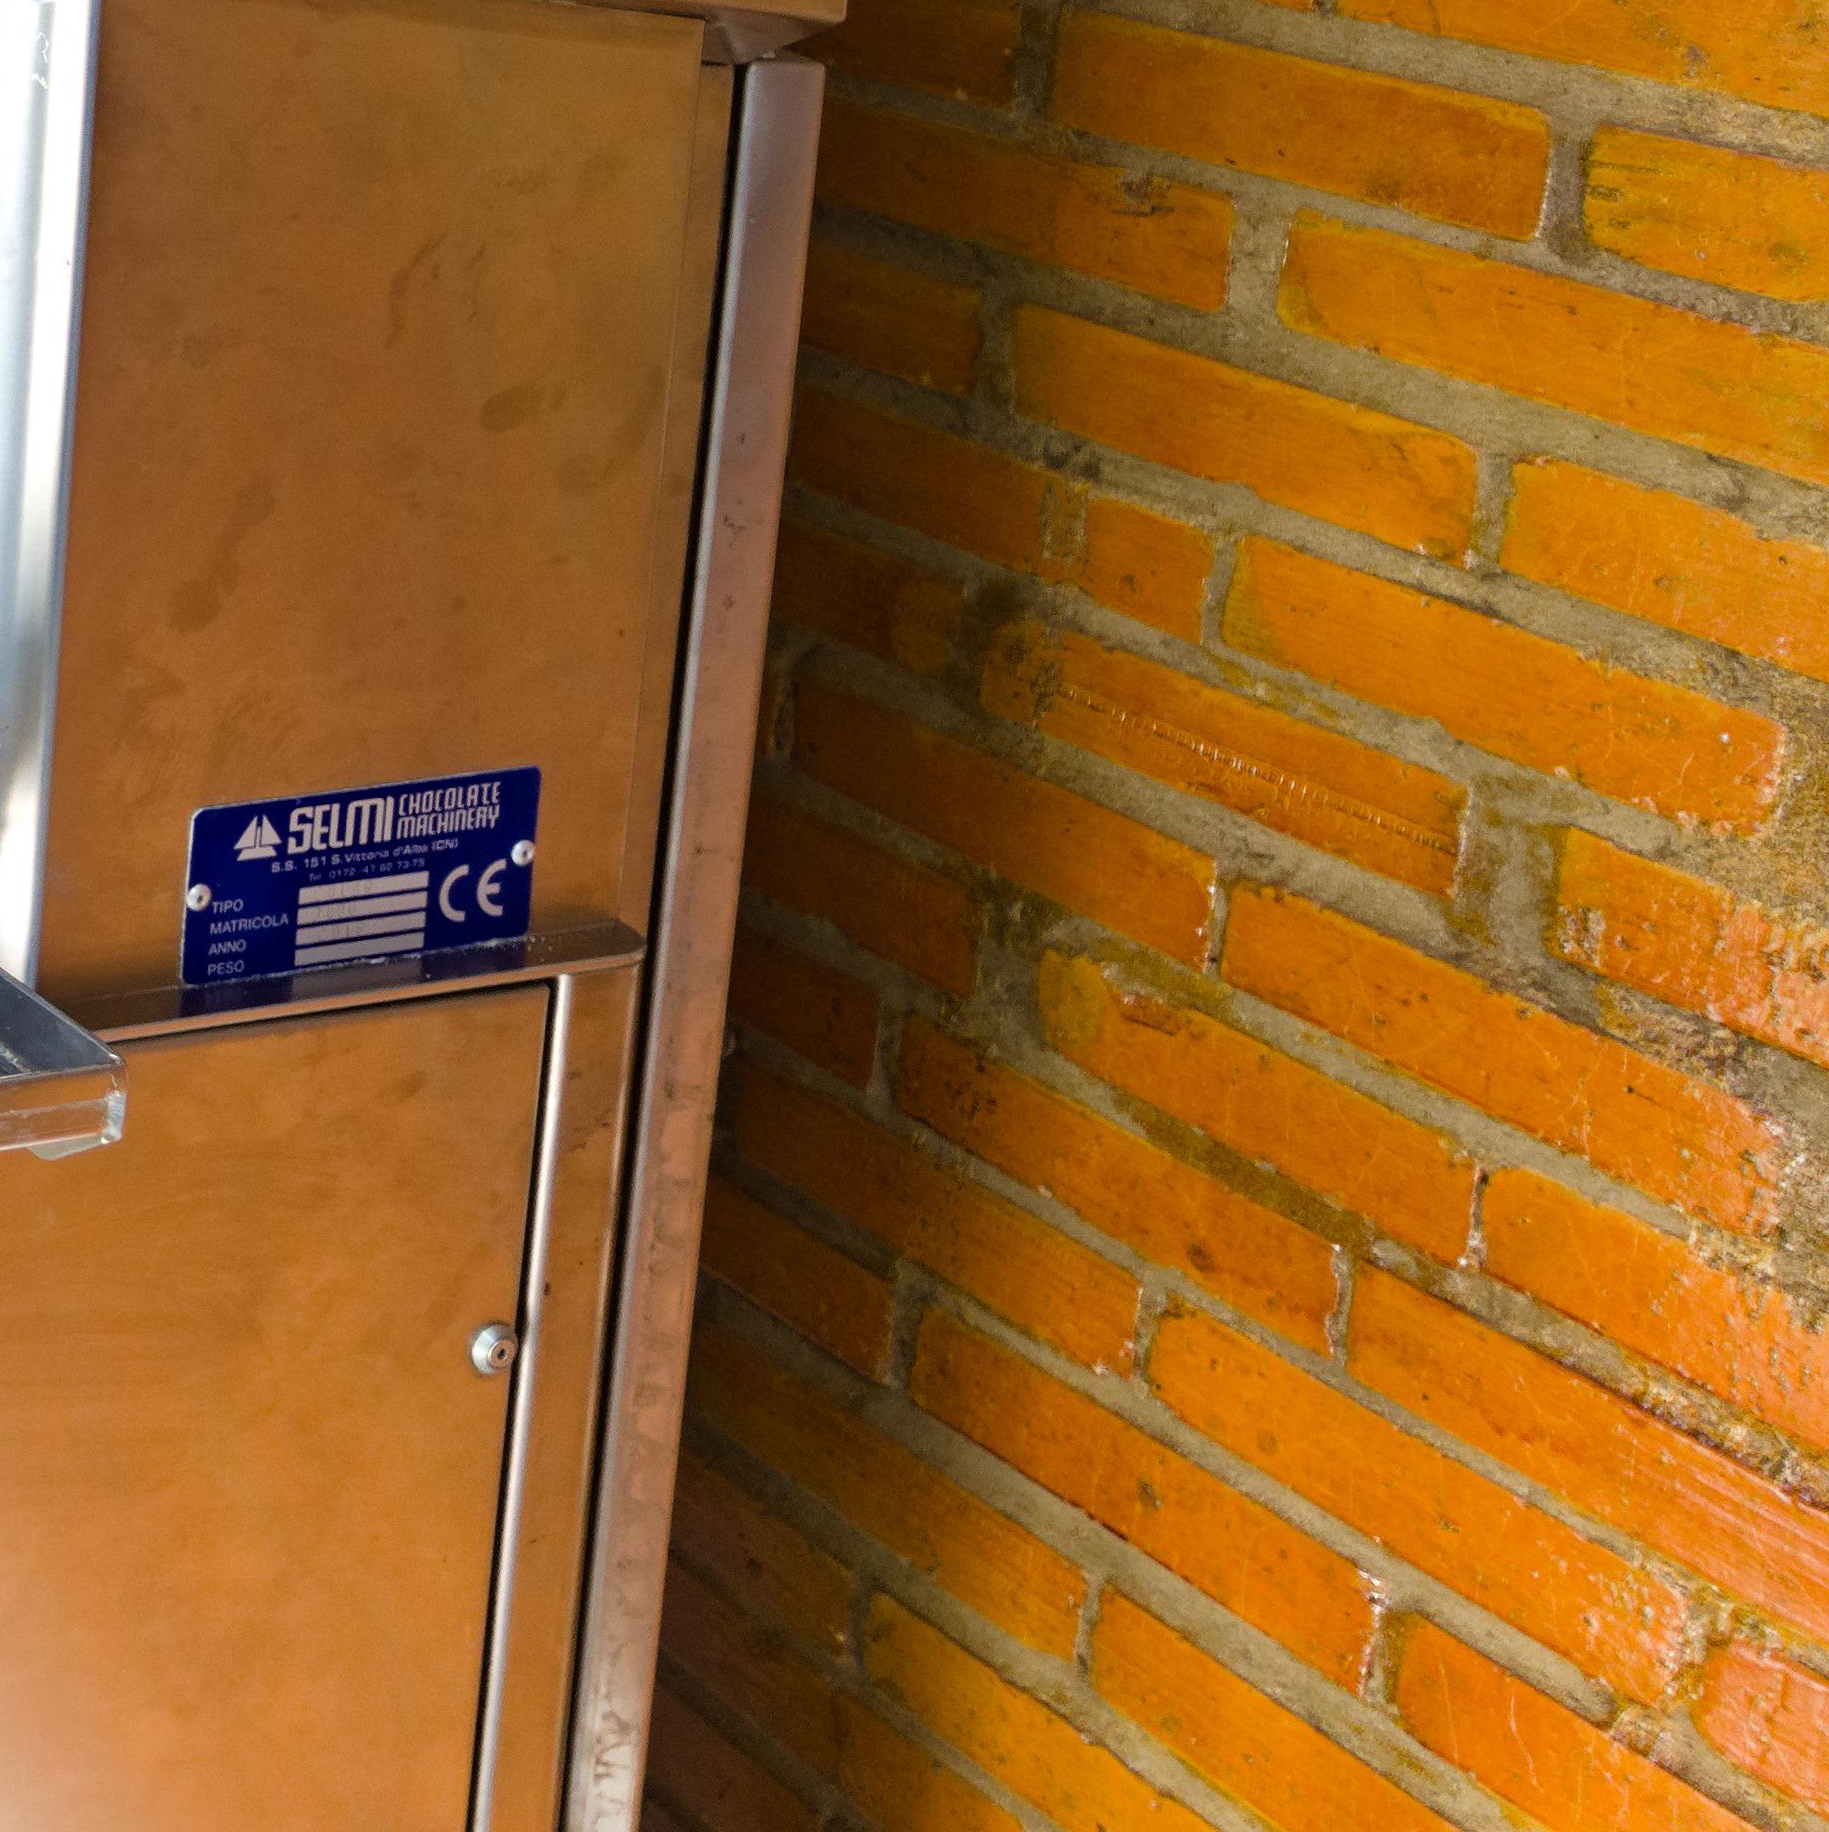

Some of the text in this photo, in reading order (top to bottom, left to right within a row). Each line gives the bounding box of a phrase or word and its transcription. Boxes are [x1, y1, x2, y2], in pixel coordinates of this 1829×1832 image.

[398, 781, 501, 816] CHOCOLATE
[287, 795, 394, 855] SELMI
[396, 804, 500, 840] MACHINERY
[439, 858, 507, 922] CE
[212, 899, 245, 915] TIPO
[210, 913, 290, 936] MATRICOLA
[208, 939, 248, 956] ANNO
[207, 960, 245, 976] PESO
